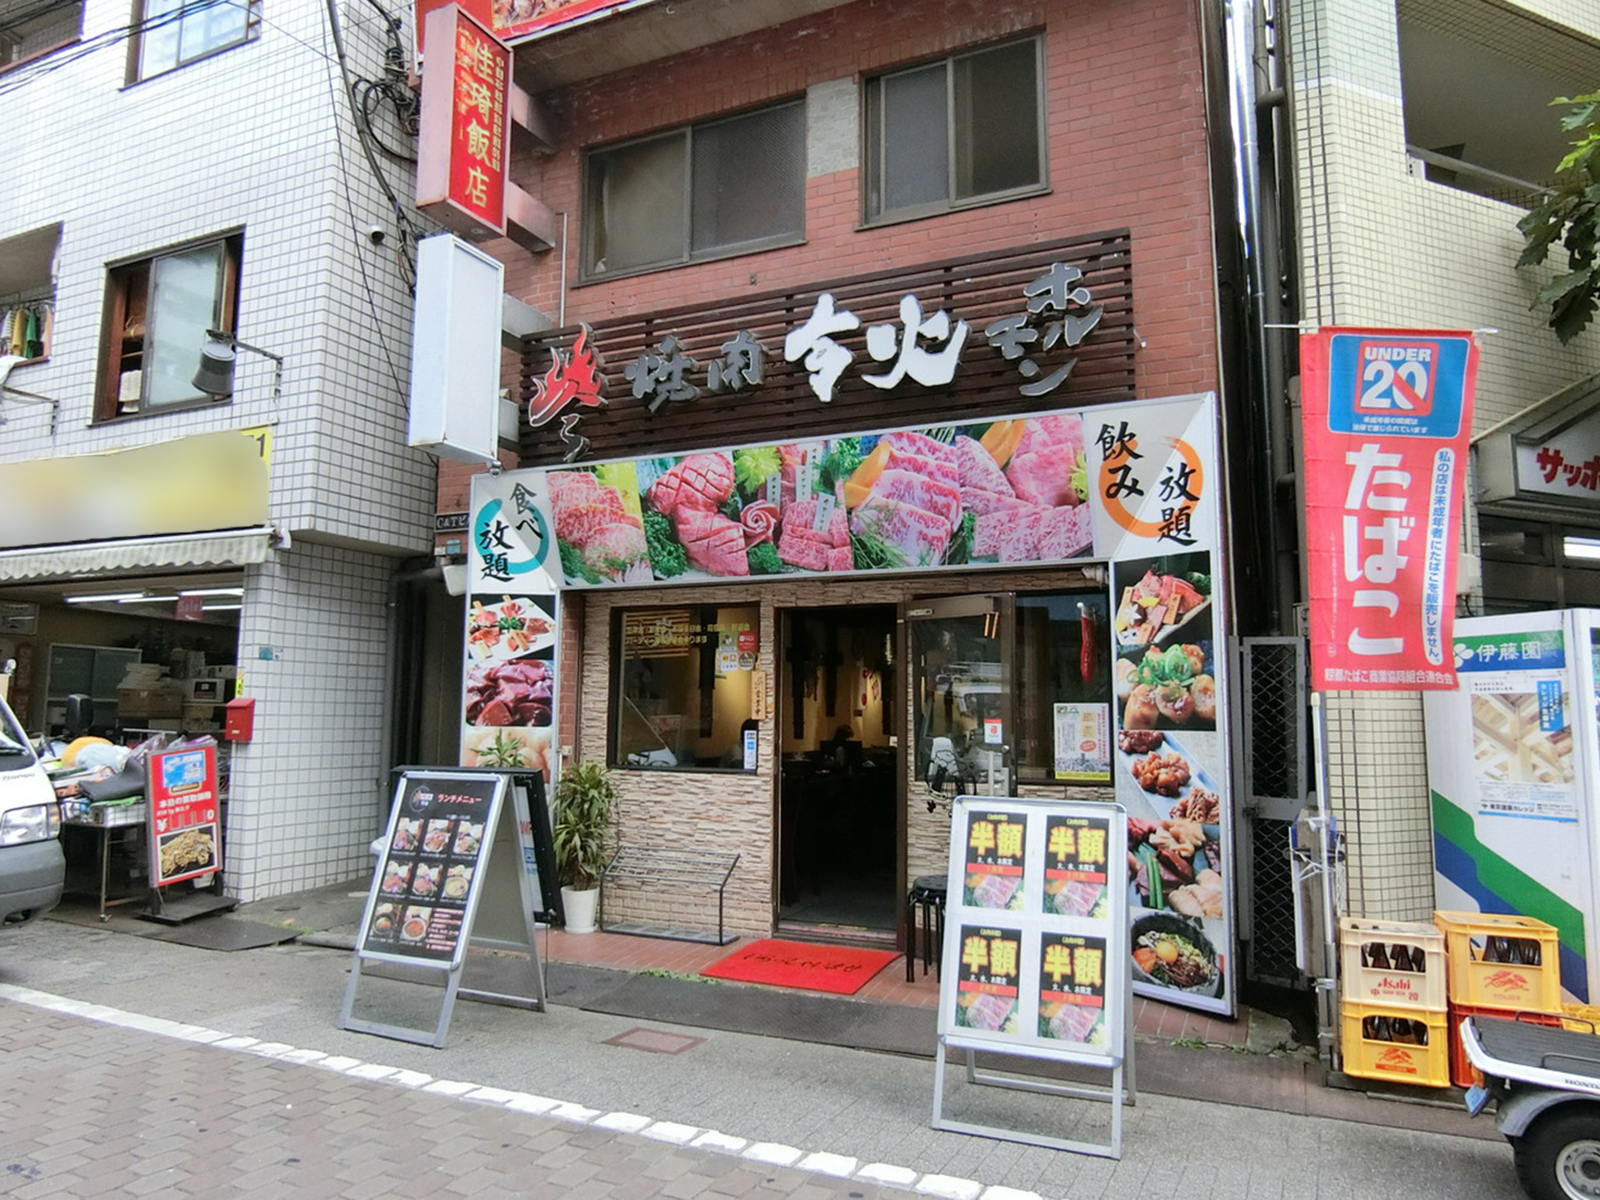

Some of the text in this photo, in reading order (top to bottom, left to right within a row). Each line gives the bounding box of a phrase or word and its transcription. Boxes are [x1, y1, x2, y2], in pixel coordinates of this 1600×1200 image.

[1363, 346, 1433, 362] UNDER
[1094, 421, 1201, 547] 飲み 放題
[436, 514, 469, 528] C&Tビ
[479, 482, 544, 582] 食べ 放題
[1343, 443, 1415, 655] たばこ
[1476, 641, 1542, 662] 伊藤園
[437, 793, 482, 804] ランチメニュー
[969, 820, 1023, 858] 半額
[1048, 825, 1106, 866] 半額
[962, 936, 1018, 978] 半額
[1043, 944, 1103, 989] 半額
[1378, 977, 1411, 991] Asahi
[1565, 1079, 1600, 1090] HOND
